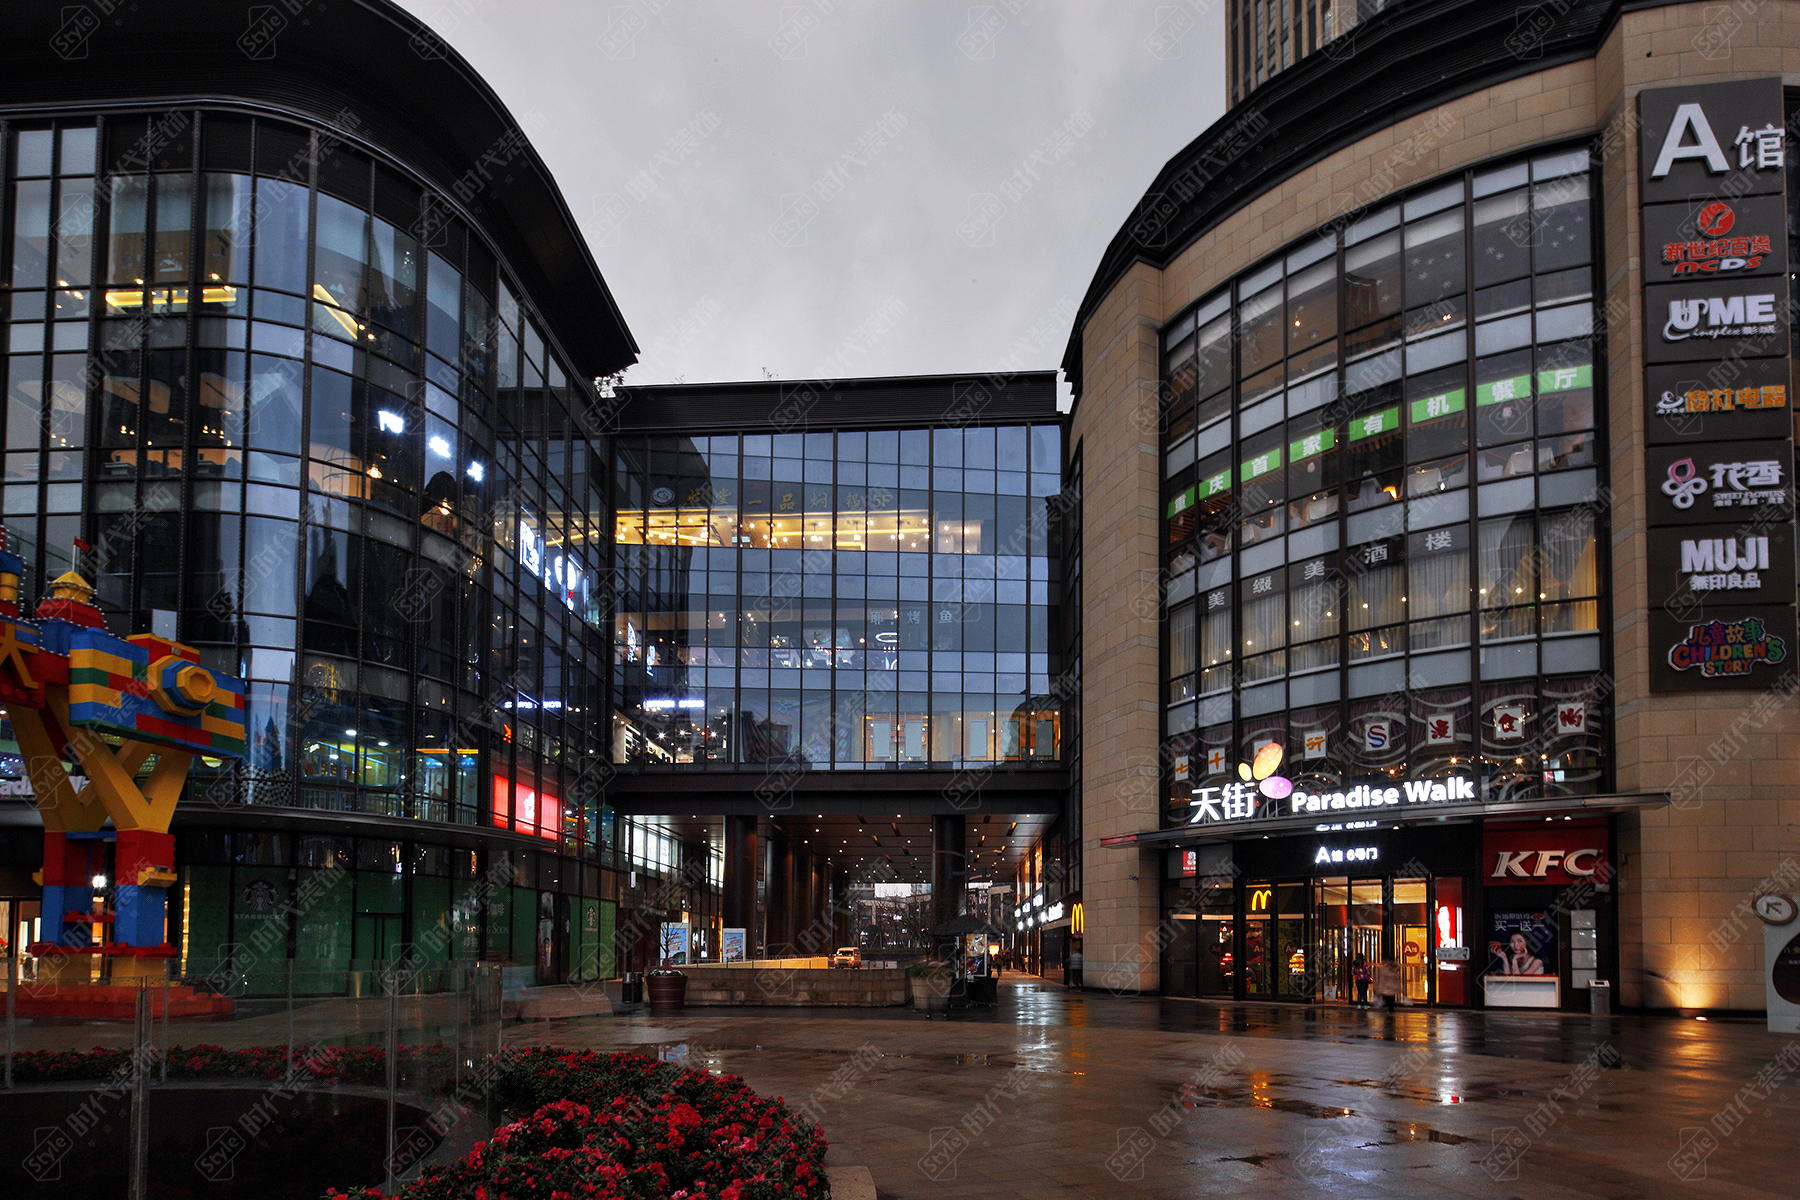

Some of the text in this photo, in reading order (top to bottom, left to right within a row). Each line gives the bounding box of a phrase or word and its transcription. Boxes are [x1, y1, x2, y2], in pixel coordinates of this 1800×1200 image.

[1662, 234, 1773, 262] 新世纪百货
[1684, 385, 1787, 413] 商社电器
[1708, 460, 1786, 492] 花香
[1680, 537, 1770, 573] MUJI
[1689, 573, 1762, 591] 無印良品
[1689, 617, 1764, 645] 儿童故事
[1669, 637, 1787, 671] CHILDREN'S
[1705, 658, 1752, 675] STORY
[1189, 777, 1475, 824] 天街 Paradise Walk
[1491, 848, 1600, 879] KFC
[1494, 920, 1546, 932] 买一送一
